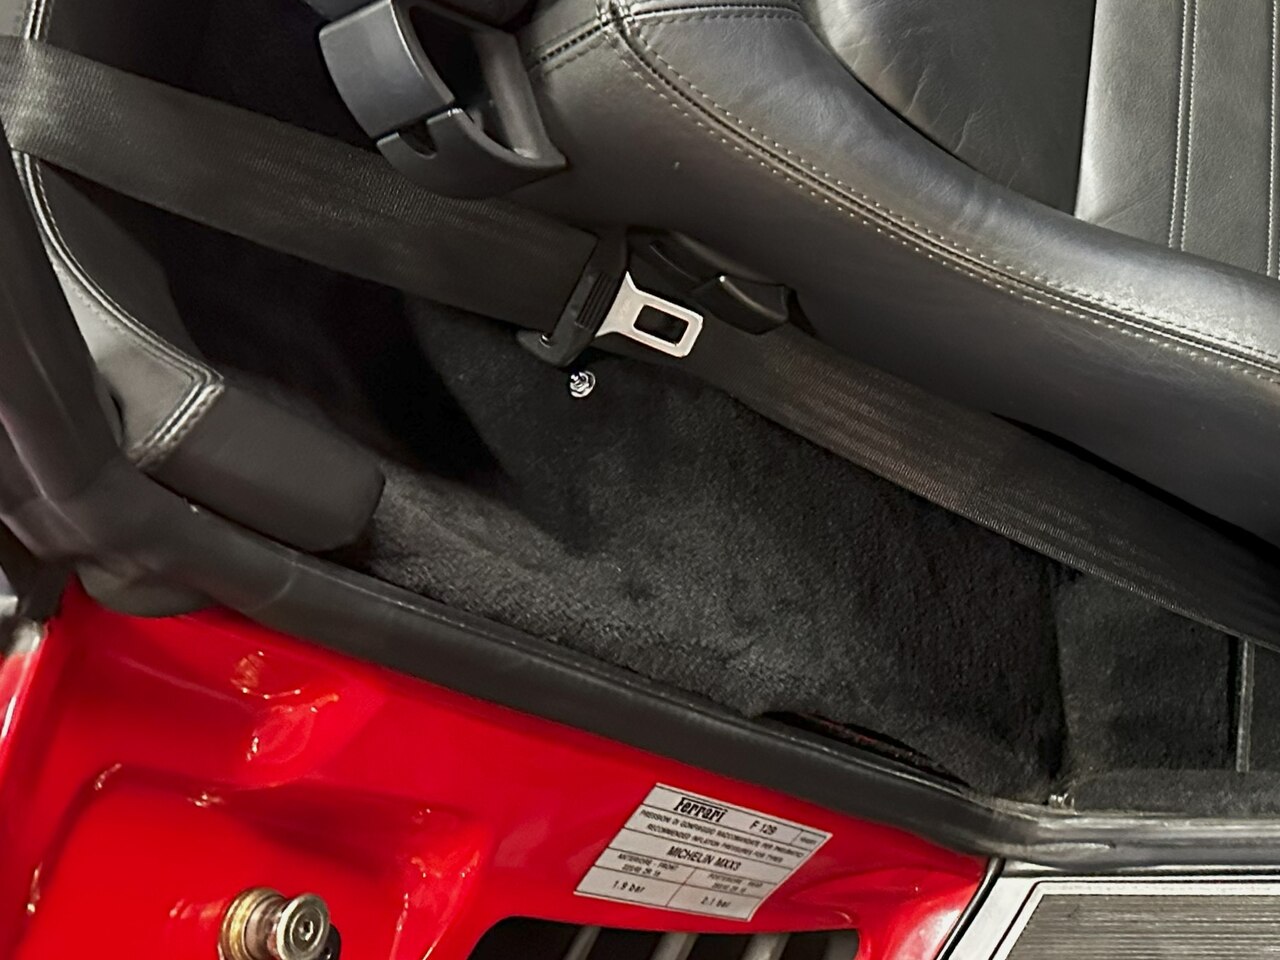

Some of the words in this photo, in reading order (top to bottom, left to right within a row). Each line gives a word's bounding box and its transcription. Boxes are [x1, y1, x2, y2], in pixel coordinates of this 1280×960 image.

[673, 797, 728, 823] Ferrari
[667, 846, 715, 864] MICHELIN
[628, 883, 646, 893] bar
